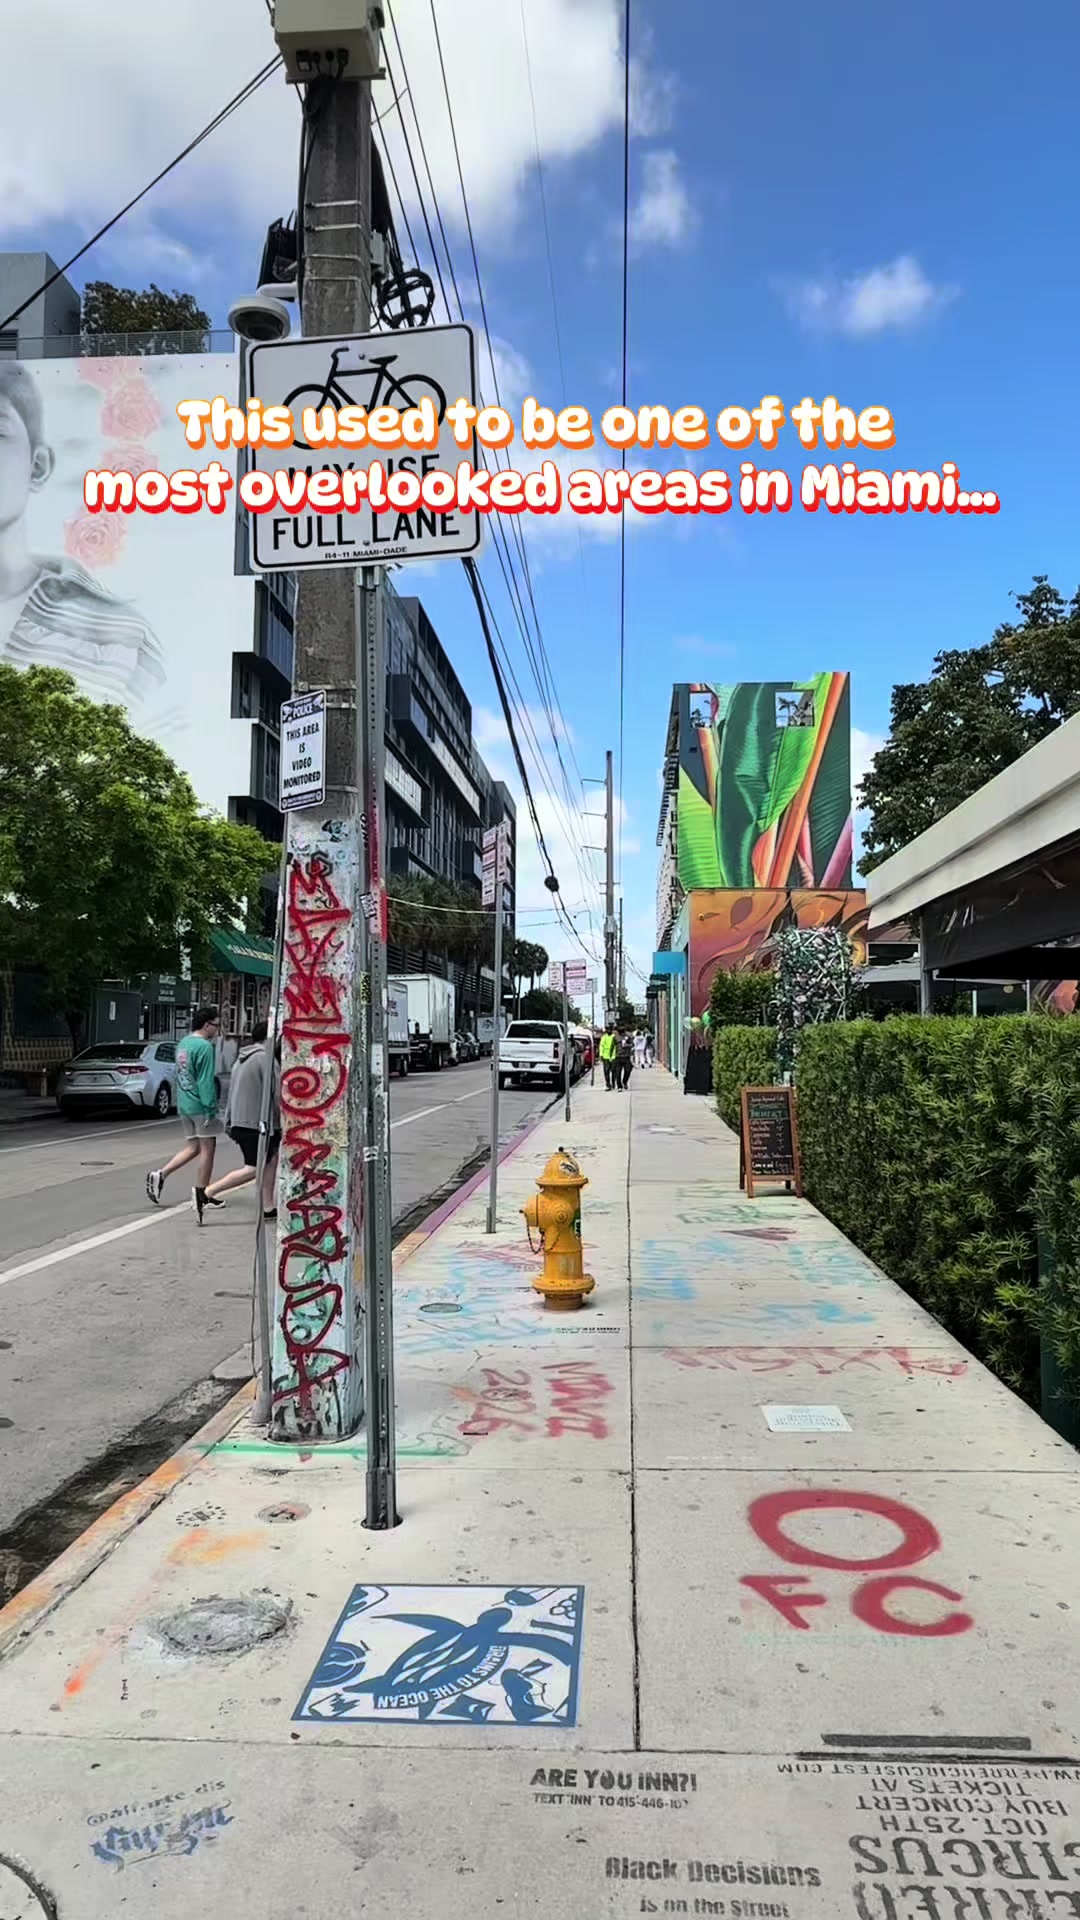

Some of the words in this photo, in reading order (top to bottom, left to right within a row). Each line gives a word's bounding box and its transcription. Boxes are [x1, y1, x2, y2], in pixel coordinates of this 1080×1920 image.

[273, 514, 355, 551] FULL
[372, 511, 460, 544] LANE
[286, 729, 301, 741] THIS
[302, 722, 320, 736] AREA
[299, 742, 306, 754] IS
[292, 757, 312, 771] VIDEO
[283, 771, 321, 789] MONITORED
[456, 1673, 477, 1688] TO
[377, 1691, 429, 1709] OCEAN
[430, 1683, 459, 1700] THE
[529, 1768, 577, 1788] ARE
[583, 1769, 632, 1791] YOU
[871, 1778, 897, 1791] AT
[909, 1780, 1031, 1797] TICKETS
[533, 1792, 564, 1804] TEXT
[598, 1795, 615, 1806] TO
[856, 1795, 994, 1813] CONCERT
[1006, 1799, 1070, 1816] BUY
[880, 1816, 965, 1834] 25TH
[971, 1817, 1048, 1836] OCT.
[605, 1857, 677, 1881] Black
[688, 1861, 822, 1888] Decisions
[664, 1899, 687, 1913] on
[694, 1897, 725, 1915] the
[731, 1899, 789, 1919] Street
